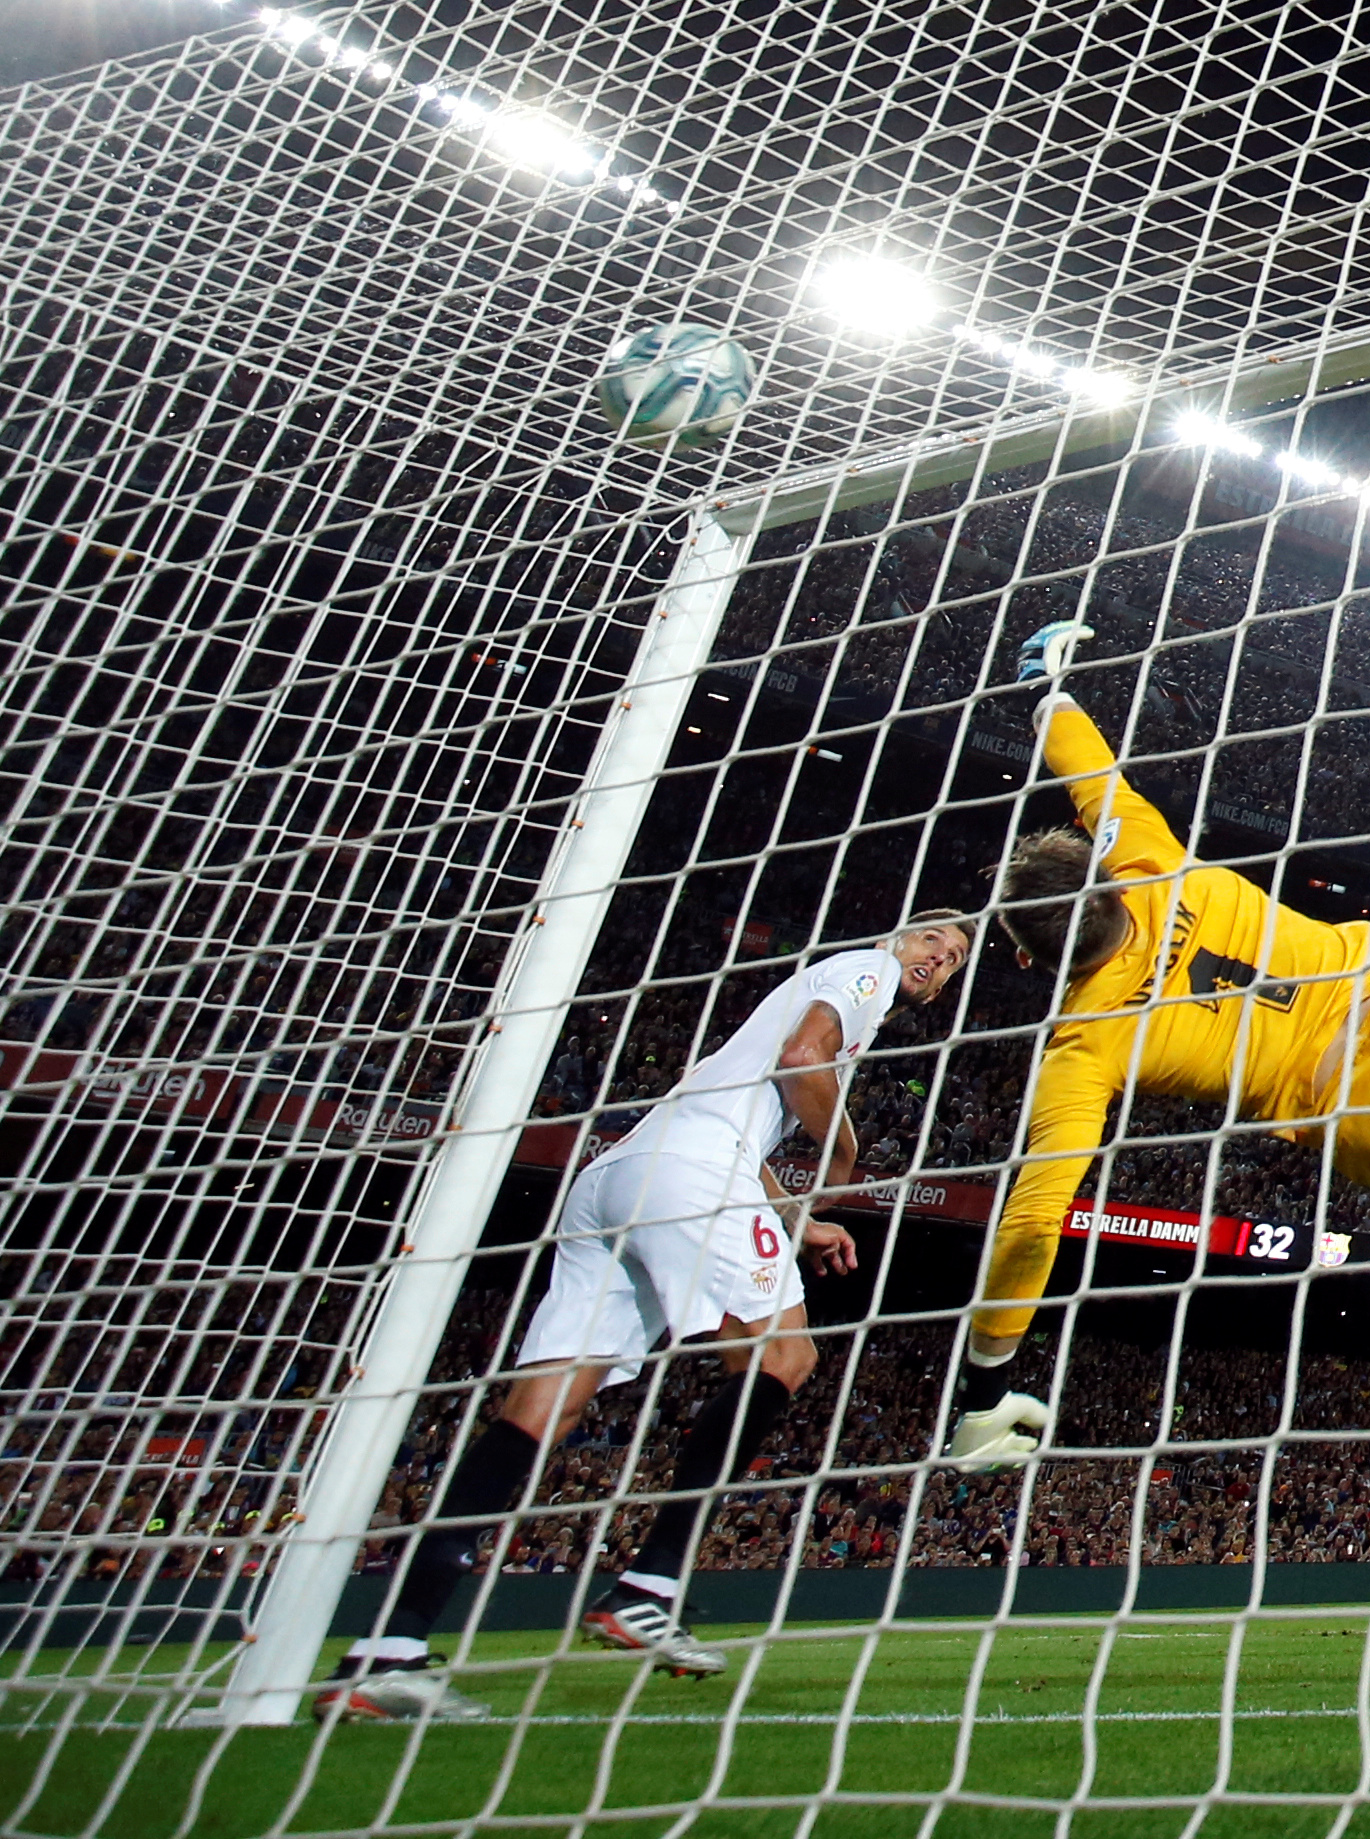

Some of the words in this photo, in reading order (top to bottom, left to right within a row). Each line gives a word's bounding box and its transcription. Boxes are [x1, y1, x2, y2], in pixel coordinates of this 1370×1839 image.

[339, 1103, 432, 1136] Rauten
[750, 1214, 780, 1260] 6
[1150, 1220, 1200, 1243] DAMM
[1249, 1223, 1295, 1260] 32
